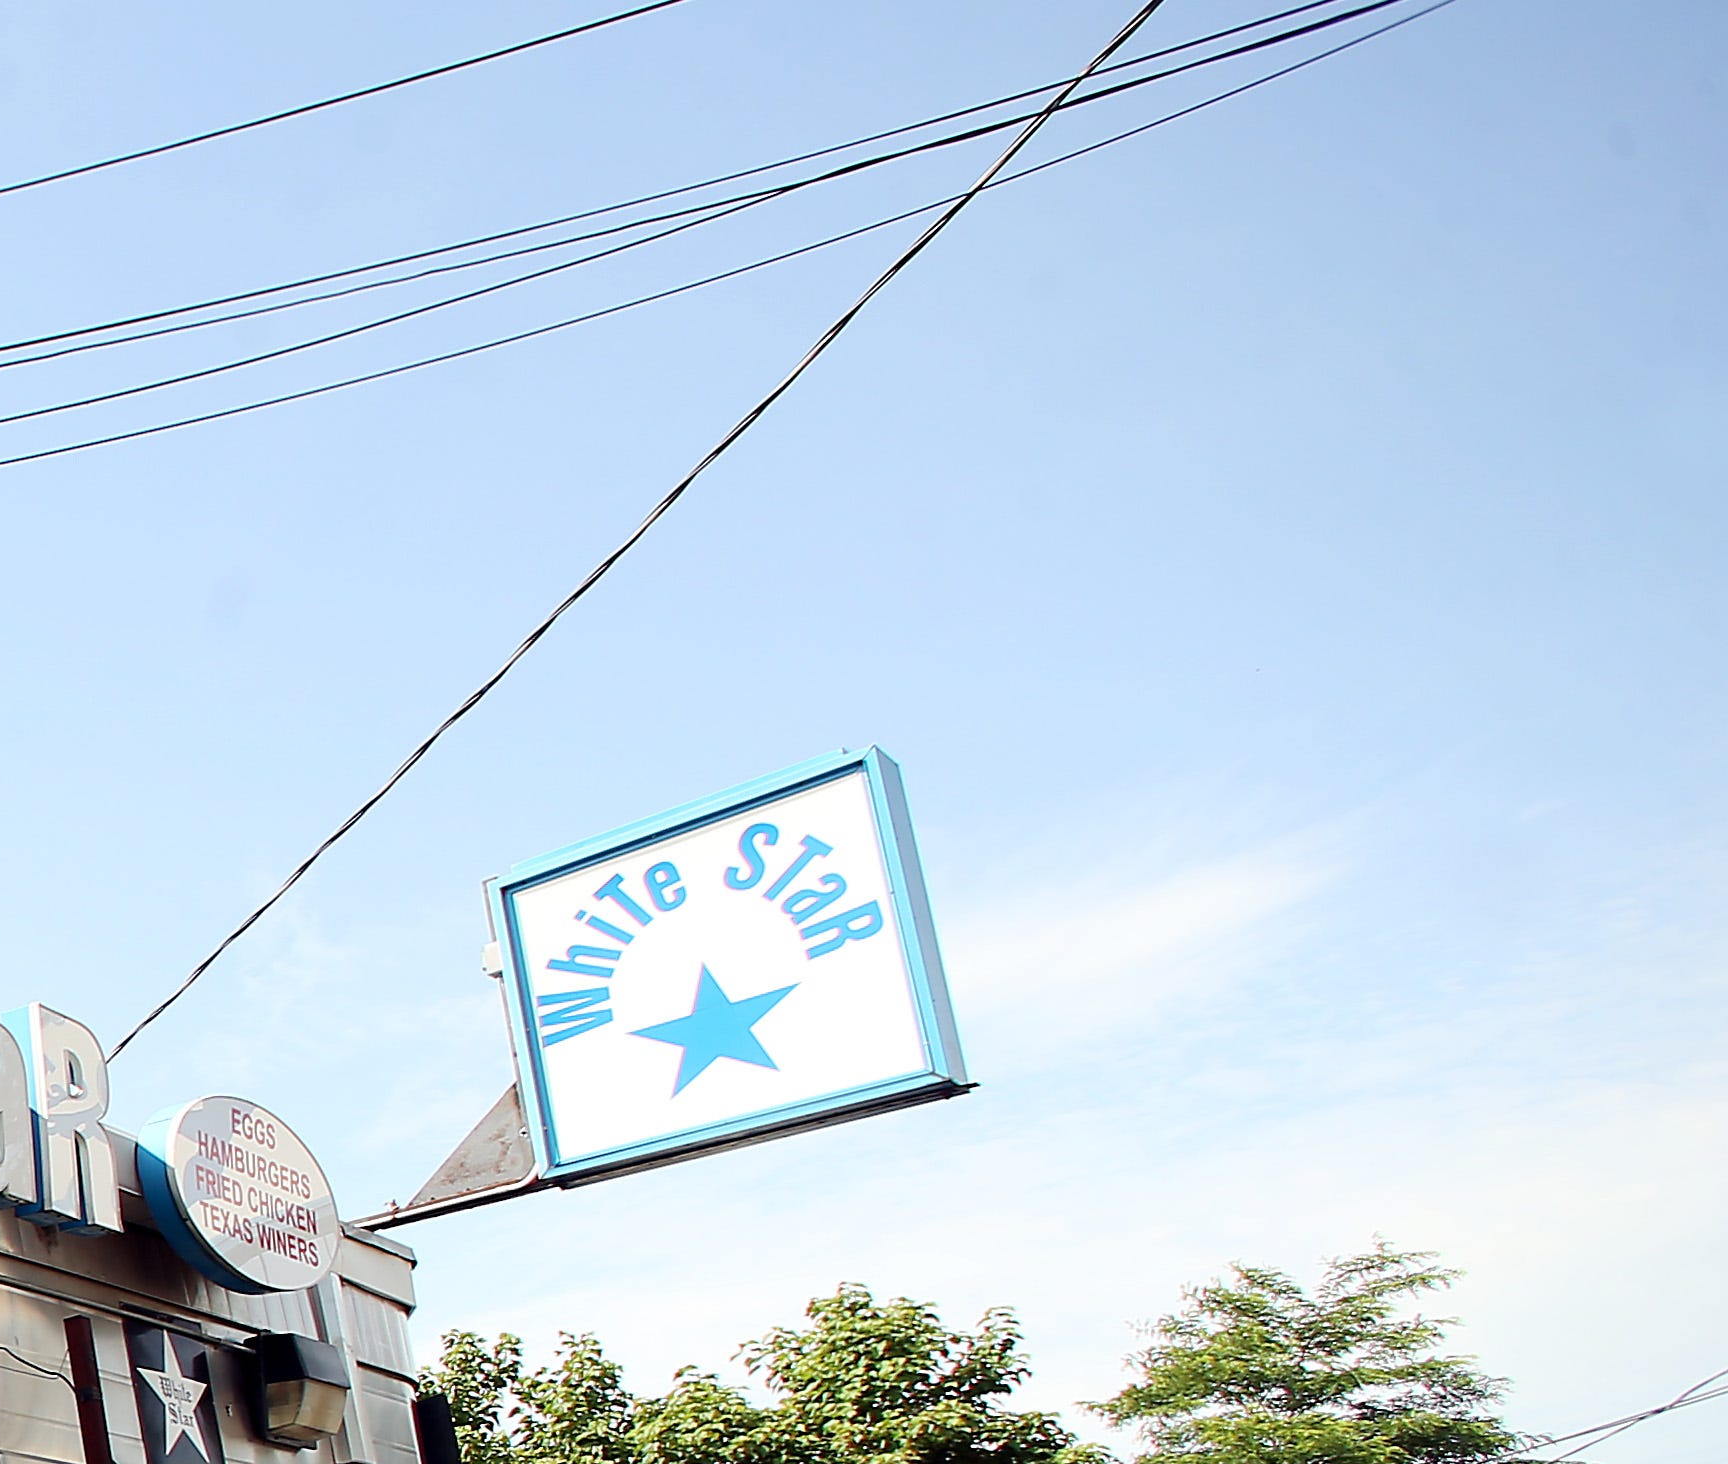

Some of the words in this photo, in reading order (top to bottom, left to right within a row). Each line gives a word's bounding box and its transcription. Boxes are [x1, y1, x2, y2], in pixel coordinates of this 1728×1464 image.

[231, 1107, 276, 1149] EGGS
[198, 1130, 311, 1199] HAMBURGERS
[196, 1164, 244, 1206] FRIED
[247, 1187, 318, 1235] CHICKEN
[199, 1201, 254, 1244] TEXAS
[256, 1224, 320, 1267] WINERS
[158, 1375, 192, 1404] White
[168, 1402, 194, 1427] Star
